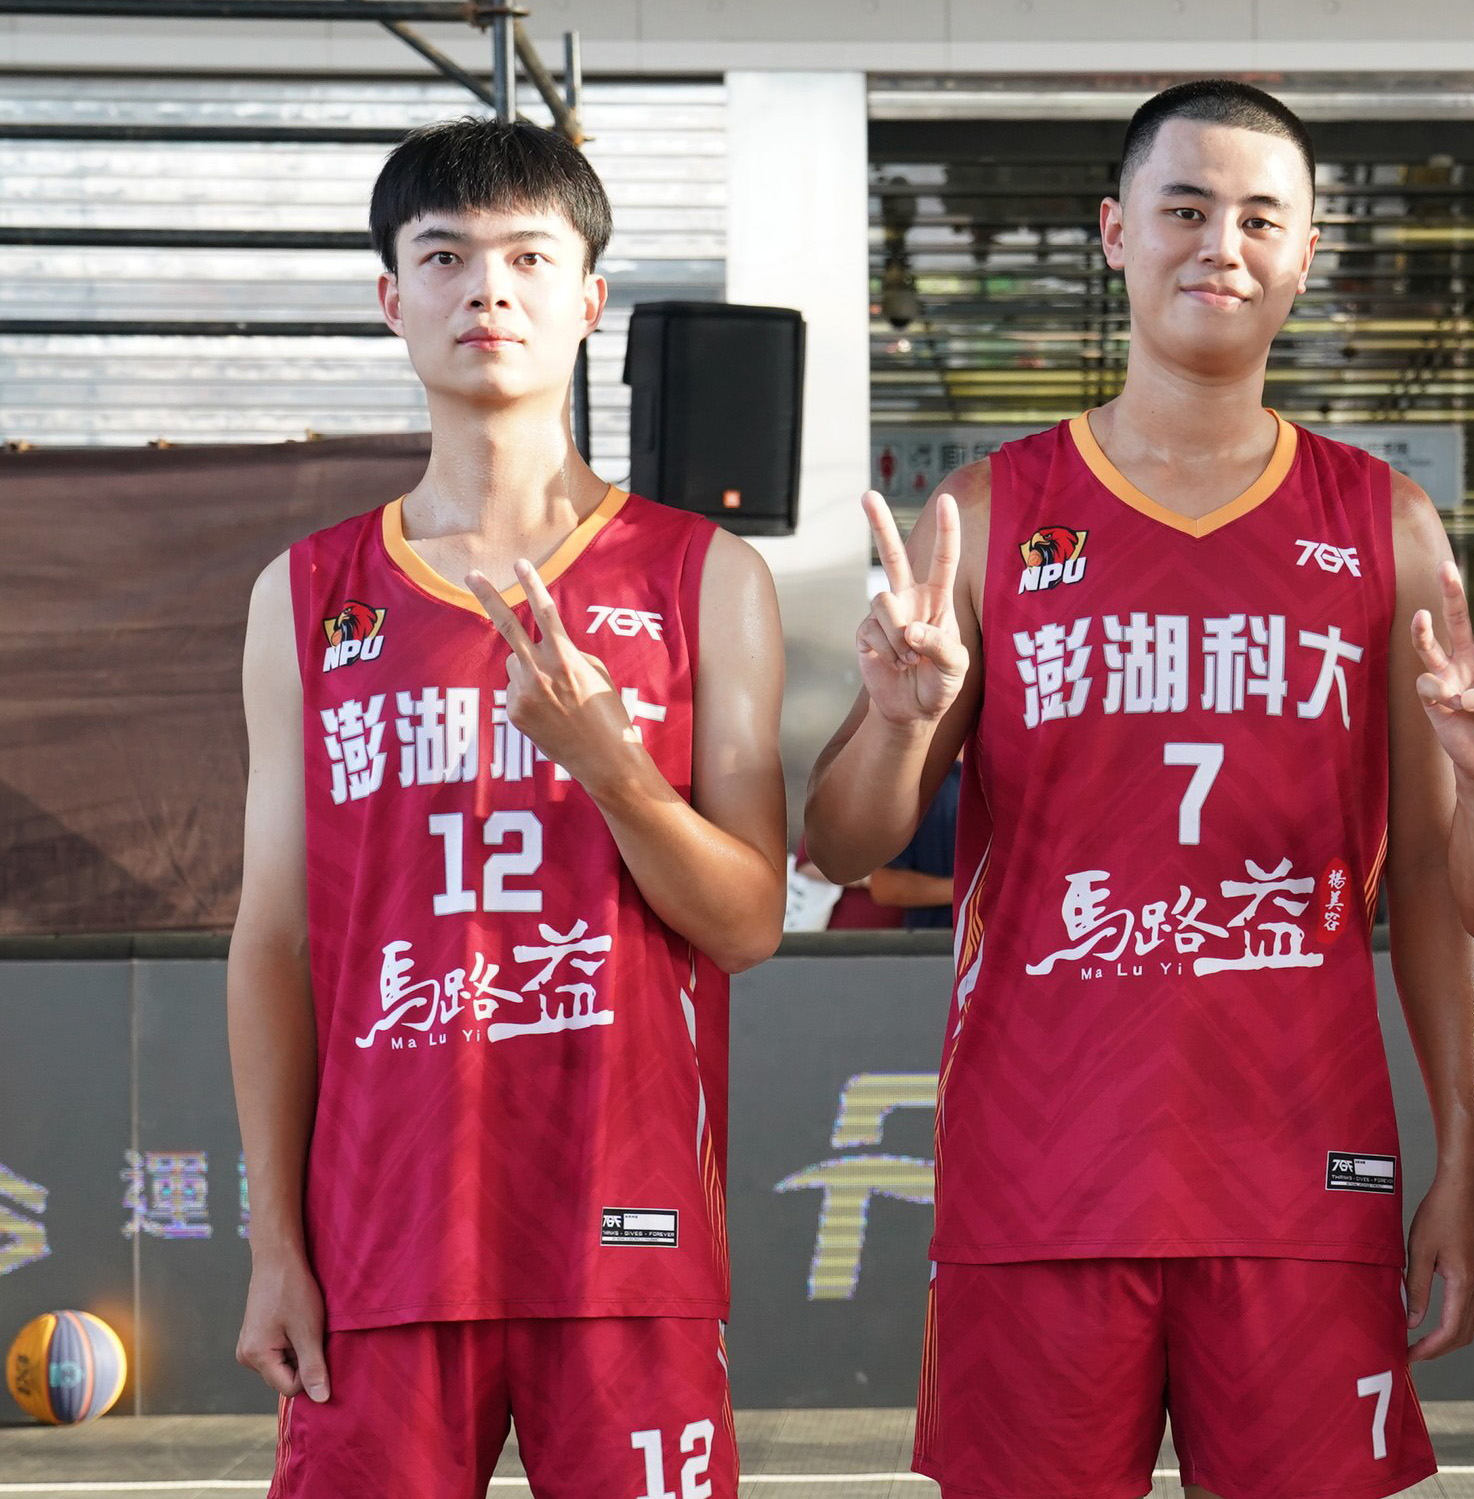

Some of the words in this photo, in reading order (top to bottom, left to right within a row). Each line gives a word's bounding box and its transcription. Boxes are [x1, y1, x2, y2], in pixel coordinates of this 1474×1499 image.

[1018, 556, 1088, 595] NPU
[322, 635, 385, 673] NPU
[1012, 612, 1364, 731] 澎湖科大
[1163, 742, 1225, 846] 7
[428, 810, 543, 916] 12
[1025, 856, 1324, 977] 馬路益
[355, 918, 615, 1049] 馬路益
[1081, 966, 1103, 981] Ma
[1117, 962, 1143, 976] Lu
[1160, 961, 1183, 975] Yi
[391, 1036, 418, 1050] Ma
[429, 1031, 448, 1047] Lu
[463, 1028, 481, 1043] Yi
[631, 1418, 714, 1499] 12
[1356, 1369, 1393, 1460] 7
